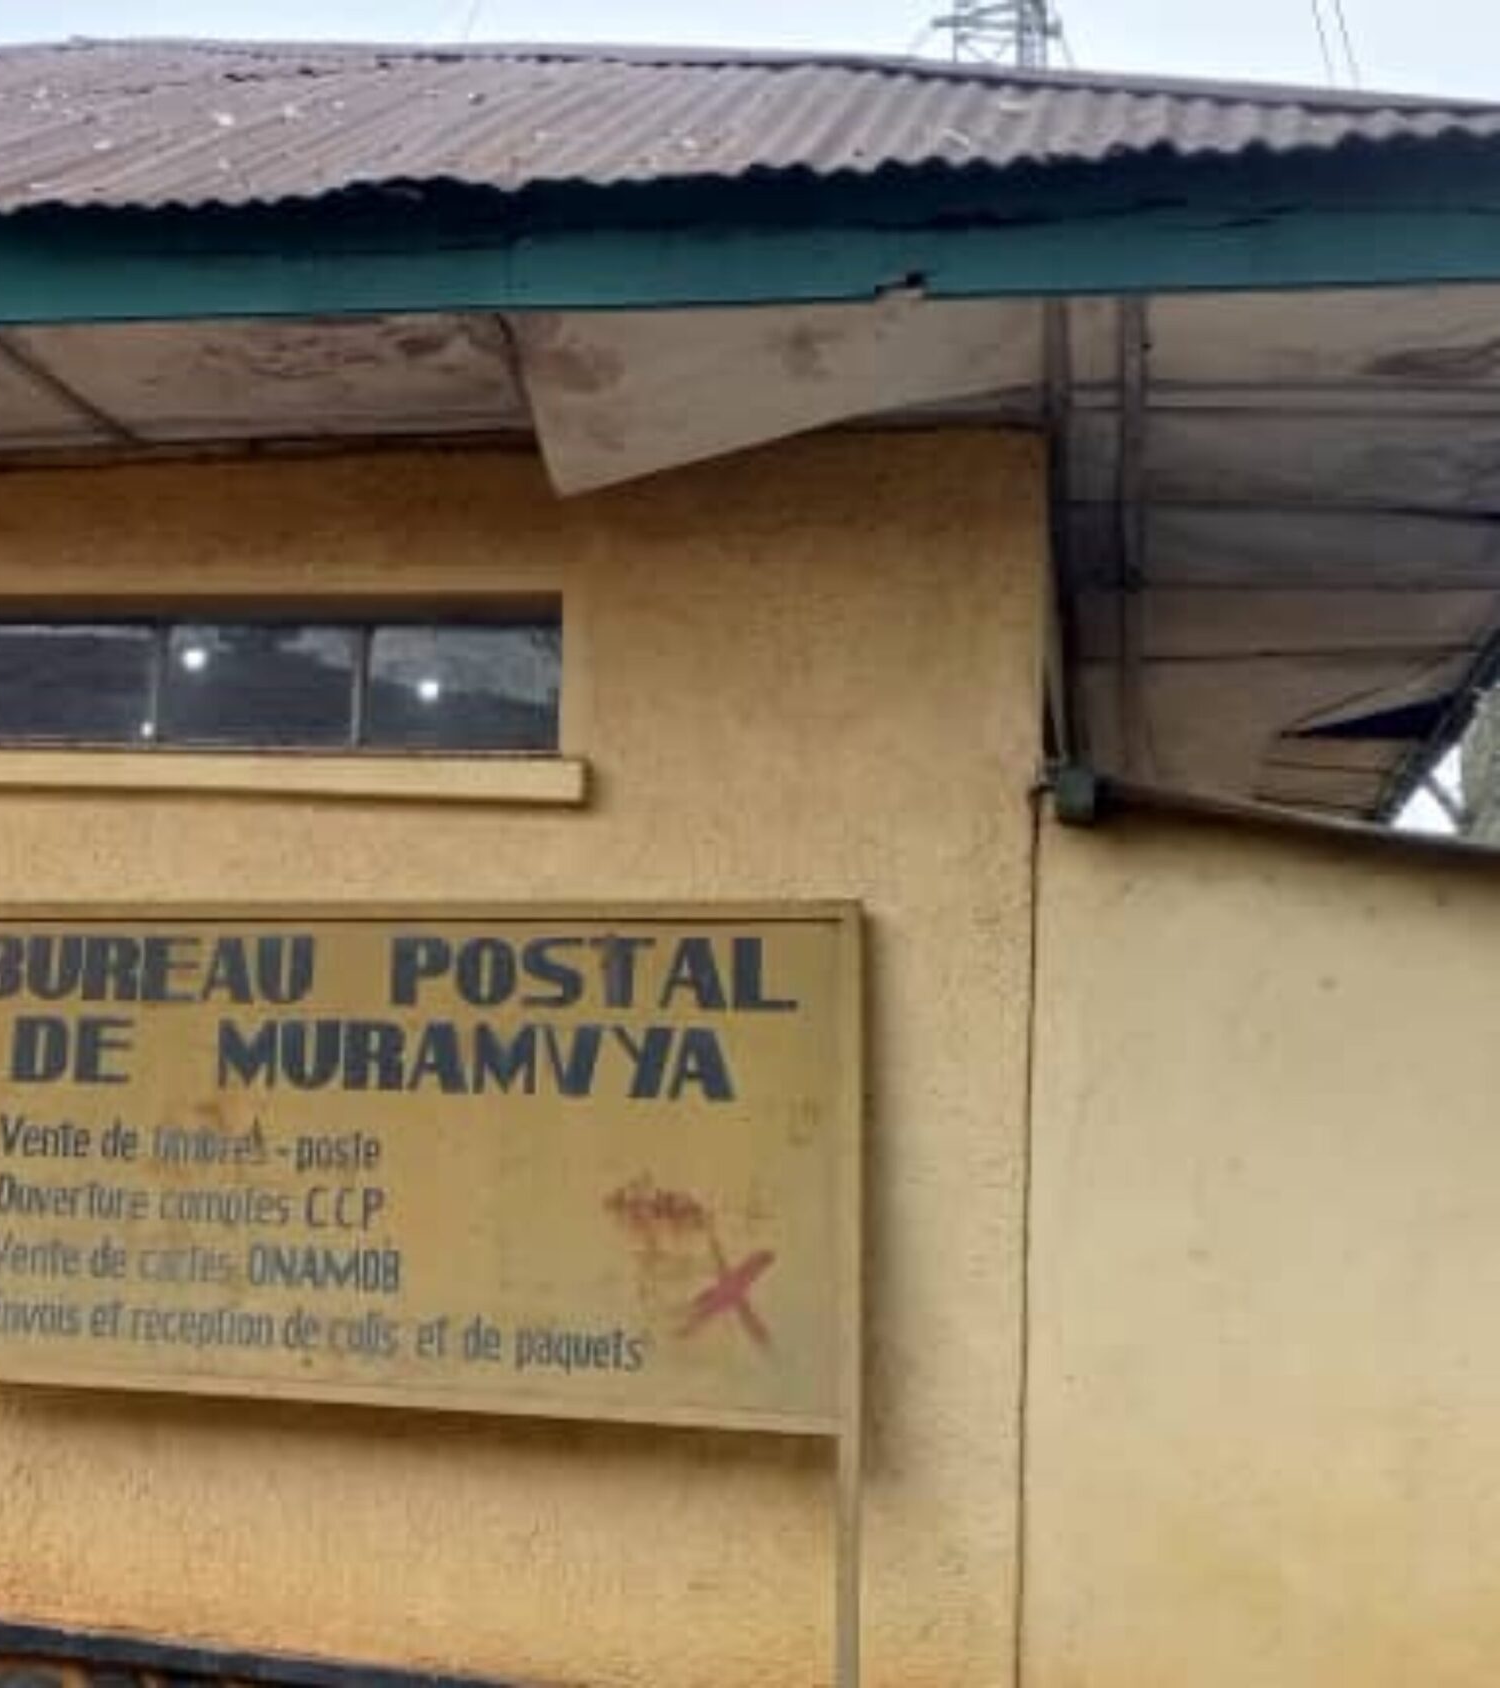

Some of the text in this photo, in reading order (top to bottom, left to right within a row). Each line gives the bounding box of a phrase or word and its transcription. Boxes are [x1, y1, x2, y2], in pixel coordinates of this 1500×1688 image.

[390, 935, 797, 1012] POSTAL
[10, 1016, 134, 1084] DE
[0, 1113, 90, 1157] Vente
[102, 1116, 137, 1161] de
[90, 1233, 126, 1278] de
[91, 1298, 120, 1337] et
[285, 1305, 320, 1350] de
[417, 1315, 446, 1358] et
[464, 1313, 501, 1361] de
[514, 1326, 644, 1376] paquets
